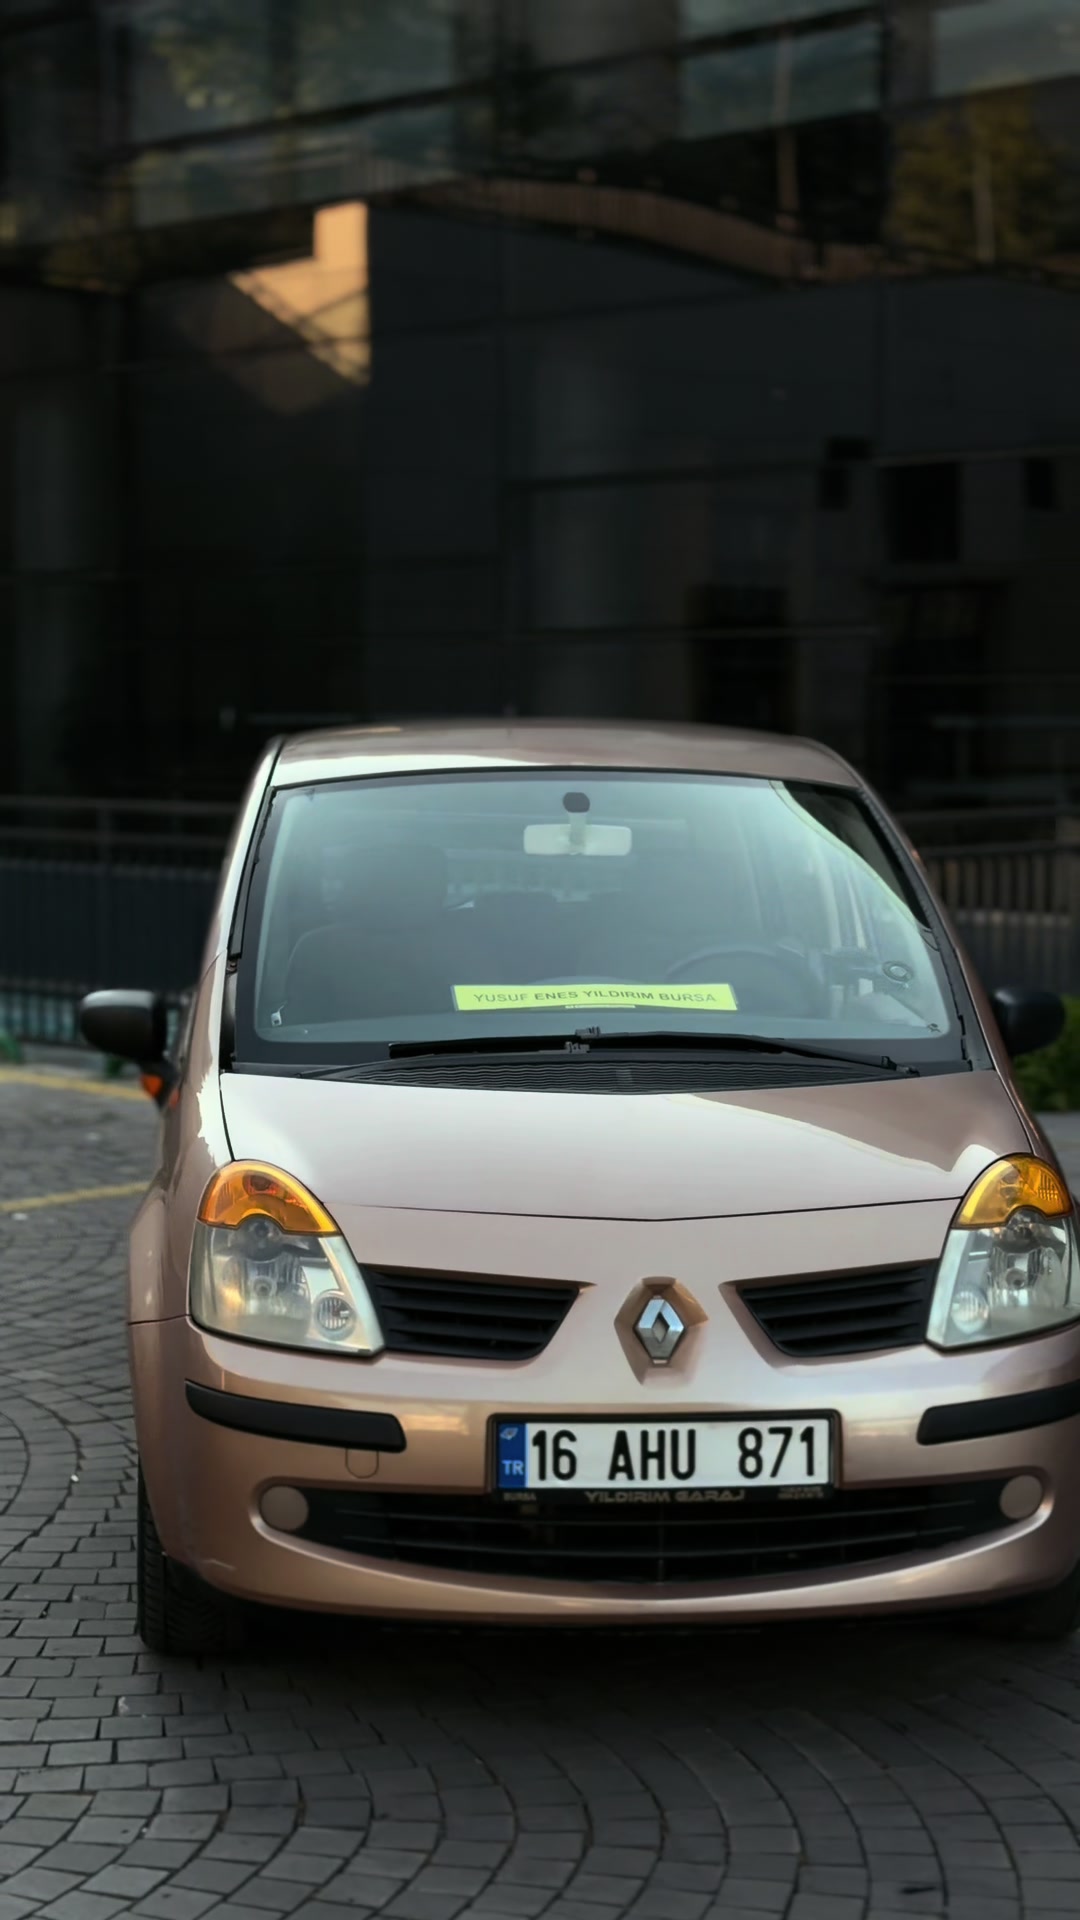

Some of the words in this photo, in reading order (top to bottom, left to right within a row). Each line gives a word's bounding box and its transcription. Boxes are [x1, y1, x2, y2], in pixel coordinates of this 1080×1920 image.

[473, 991, 528, 1003] YUSUF
[534, 991, 578, 1001] ENES
[584, 990, 653, 1000] YILDIRIM
[659, 992, 716, 1002] BURSA
[532, 1430, 577, 1481] 16
[608, 1429, 696, 1481] AHU
[738, 1426, 814, 1479] 871
[502, 1459, 524, 1475] TR
[585, 1491, 671, 1503] YILDIRIM
[675, 1489, 745, 1502] GARAJ
